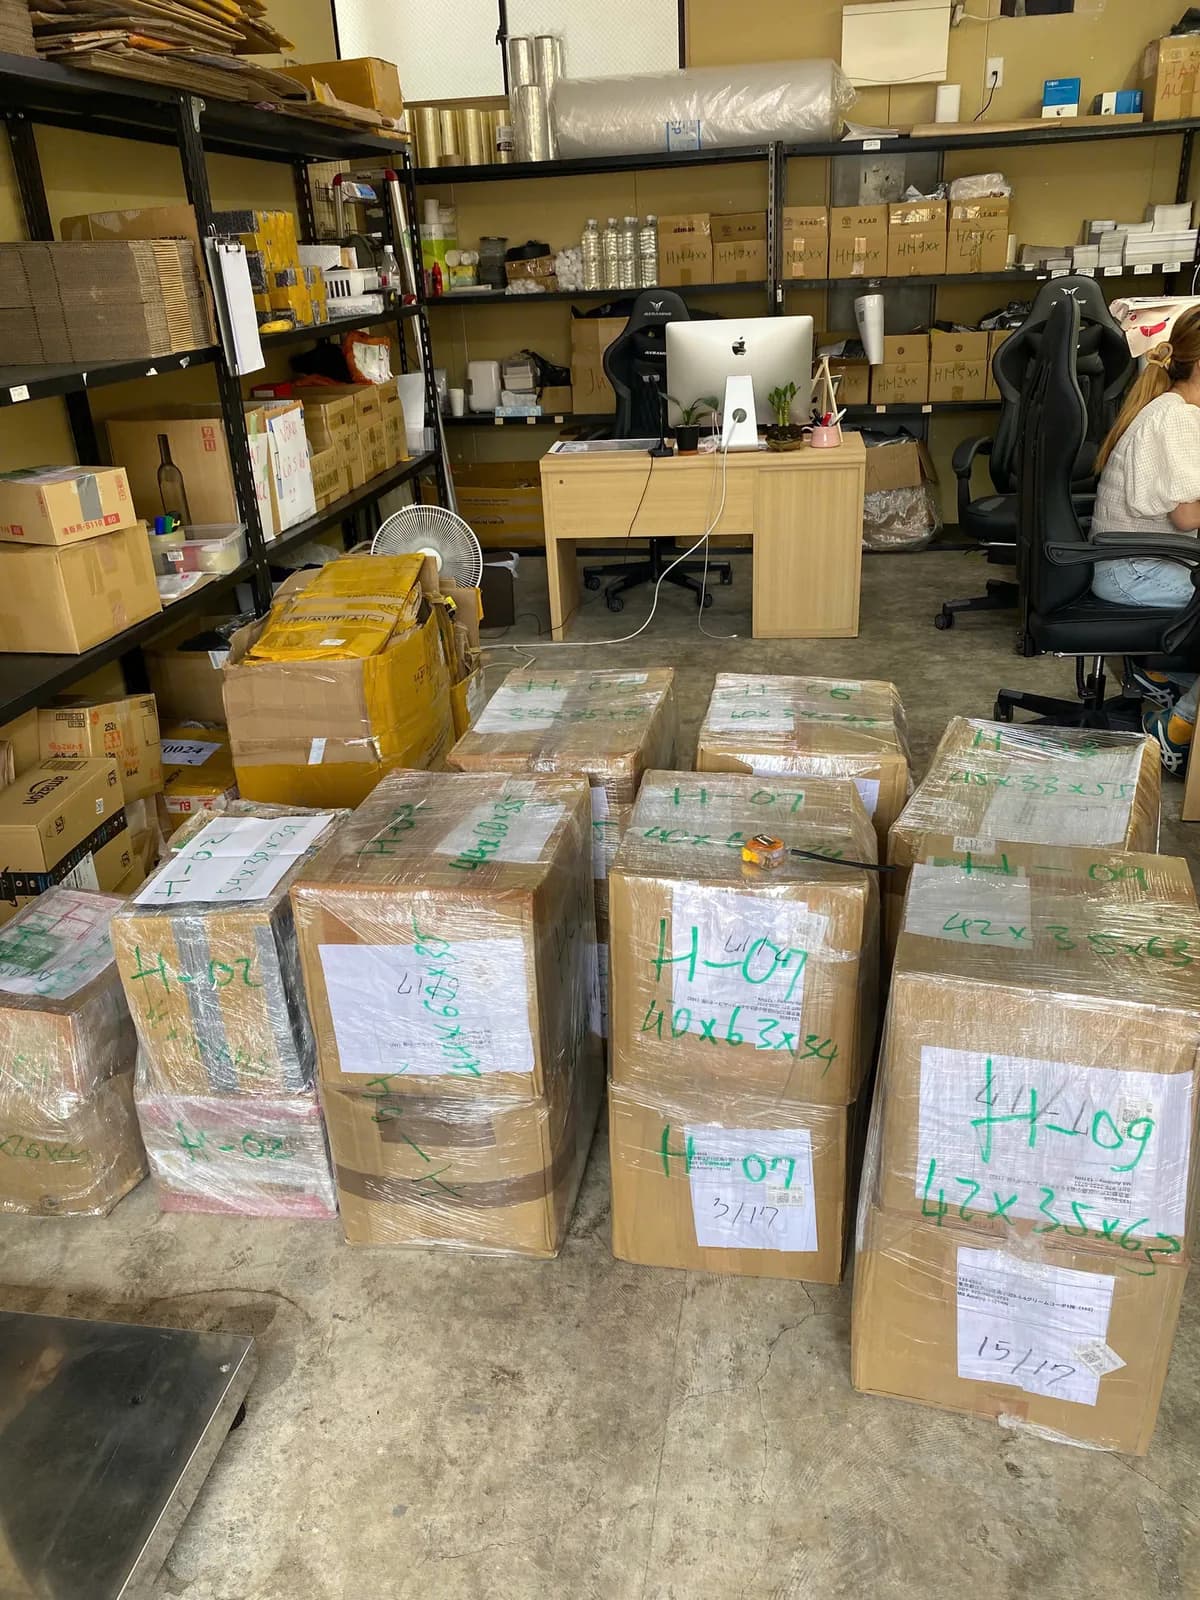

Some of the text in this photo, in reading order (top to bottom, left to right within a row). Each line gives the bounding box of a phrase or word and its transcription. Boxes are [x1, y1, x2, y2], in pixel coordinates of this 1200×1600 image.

[22, 775, 70, 805] amazon
[154, 832, 233, 898] H-02
[650, 917, 808, 1002] H-07
[641, 999, 840, 1078] 40x63x34
[970, 1057, 1156, 1172] H-09
[920, 1158, 1182, 1278] 42x35x63
[977, 1335, 1077, 1387] 15/17
